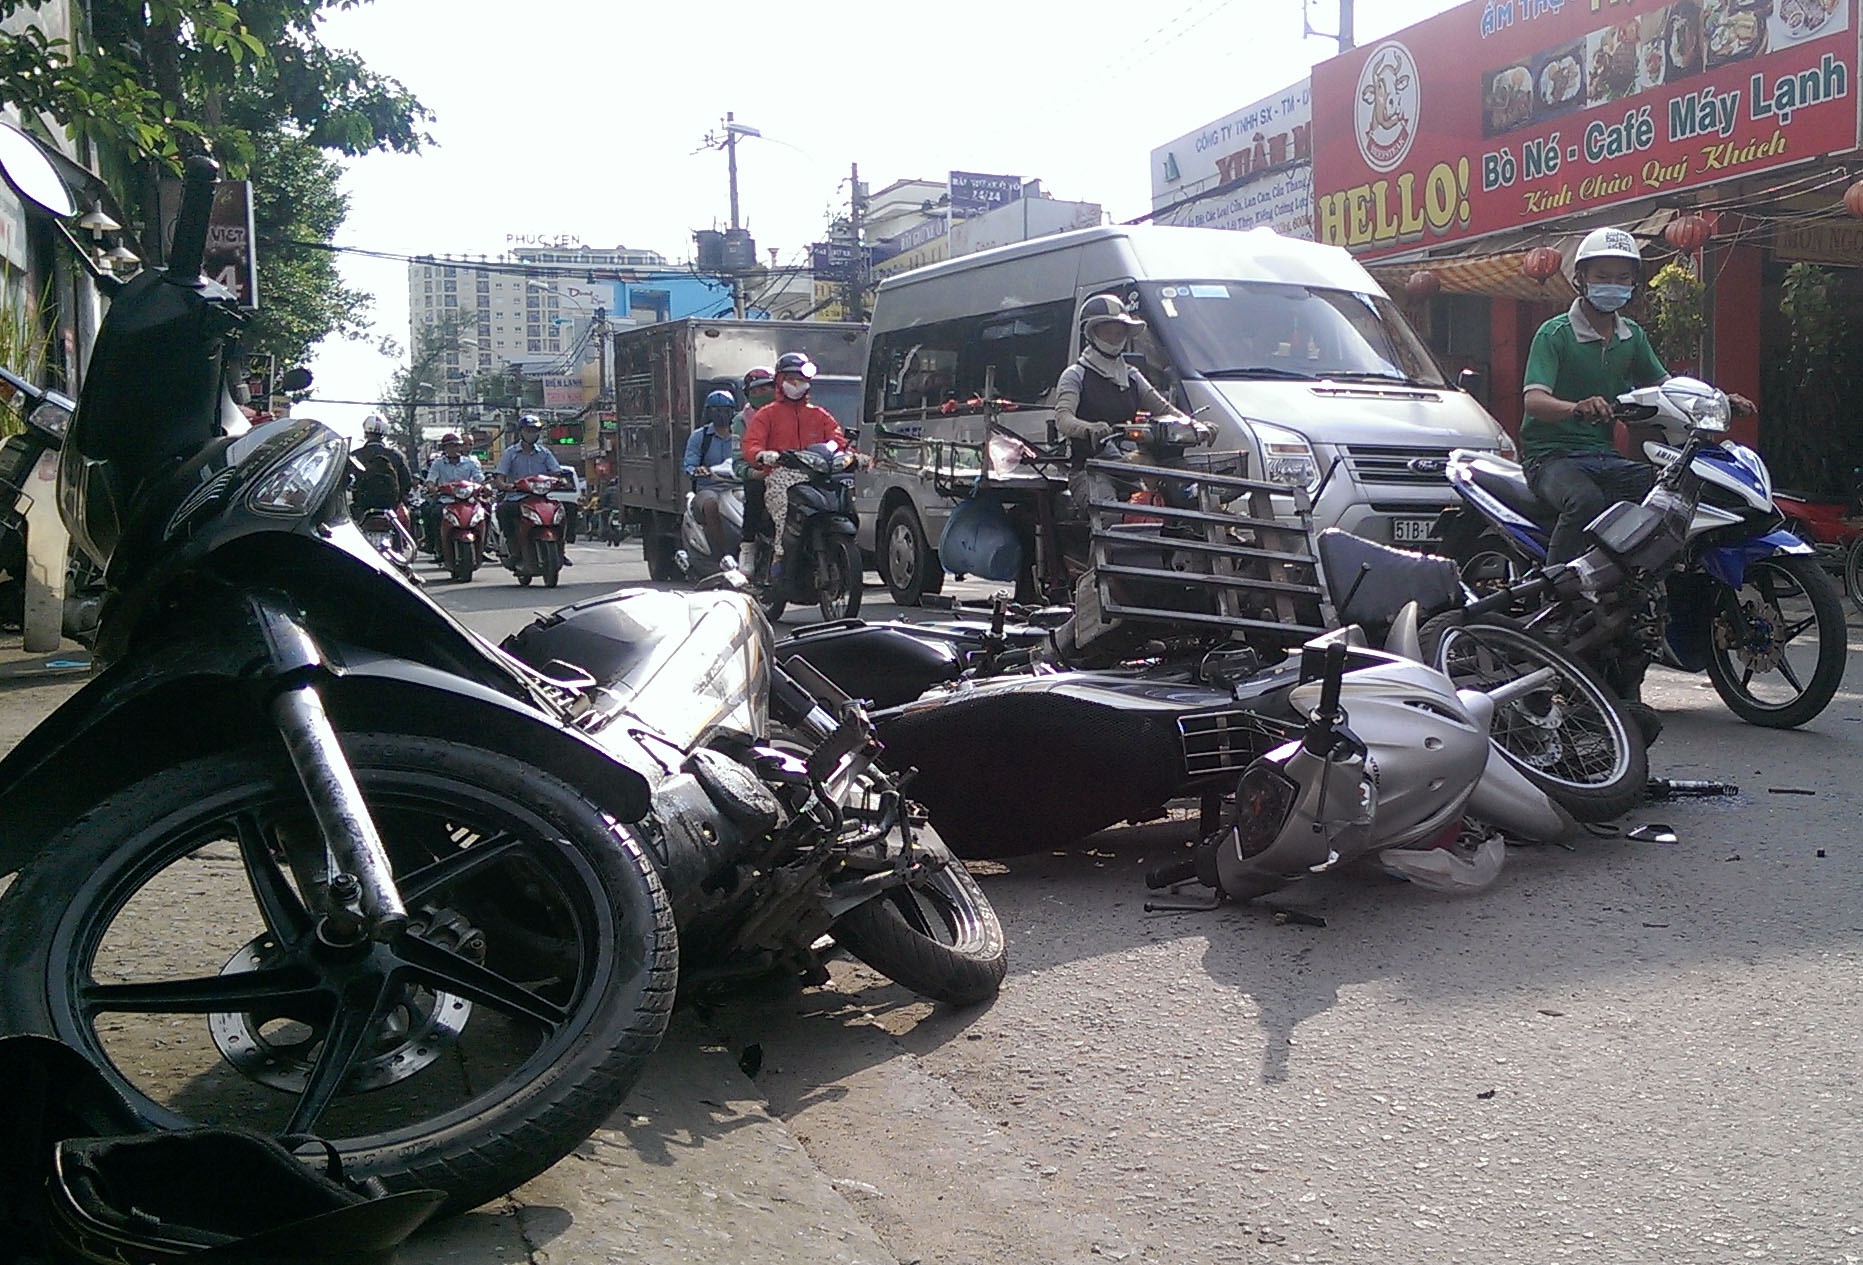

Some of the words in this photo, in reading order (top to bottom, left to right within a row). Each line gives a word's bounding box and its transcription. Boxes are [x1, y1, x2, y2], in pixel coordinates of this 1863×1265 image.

[1221, 124, 1233, 142] TY
[1235, 111, 1258, 136] TNHH
[1260, 105, 1272, 125] SX
[1281, 95, 1295, 116] TM
[1483, 148, 1516, 191] Bò
[1523, 132, 1560, 180] Né
[1585, 105, 1655, 163] Café
[1669, 87, 1740, 143] Máy
[1751, 52, 1847, 125] Lạnh
[1319, 157, 1470, 248] HELLO!
[1519, 184, 1573, 215] Kính
[1579, 173, 1633, 200] Chào
[1641, 155, 1688, 188] Quý
[1696, 130, 1786, 174] Khách
